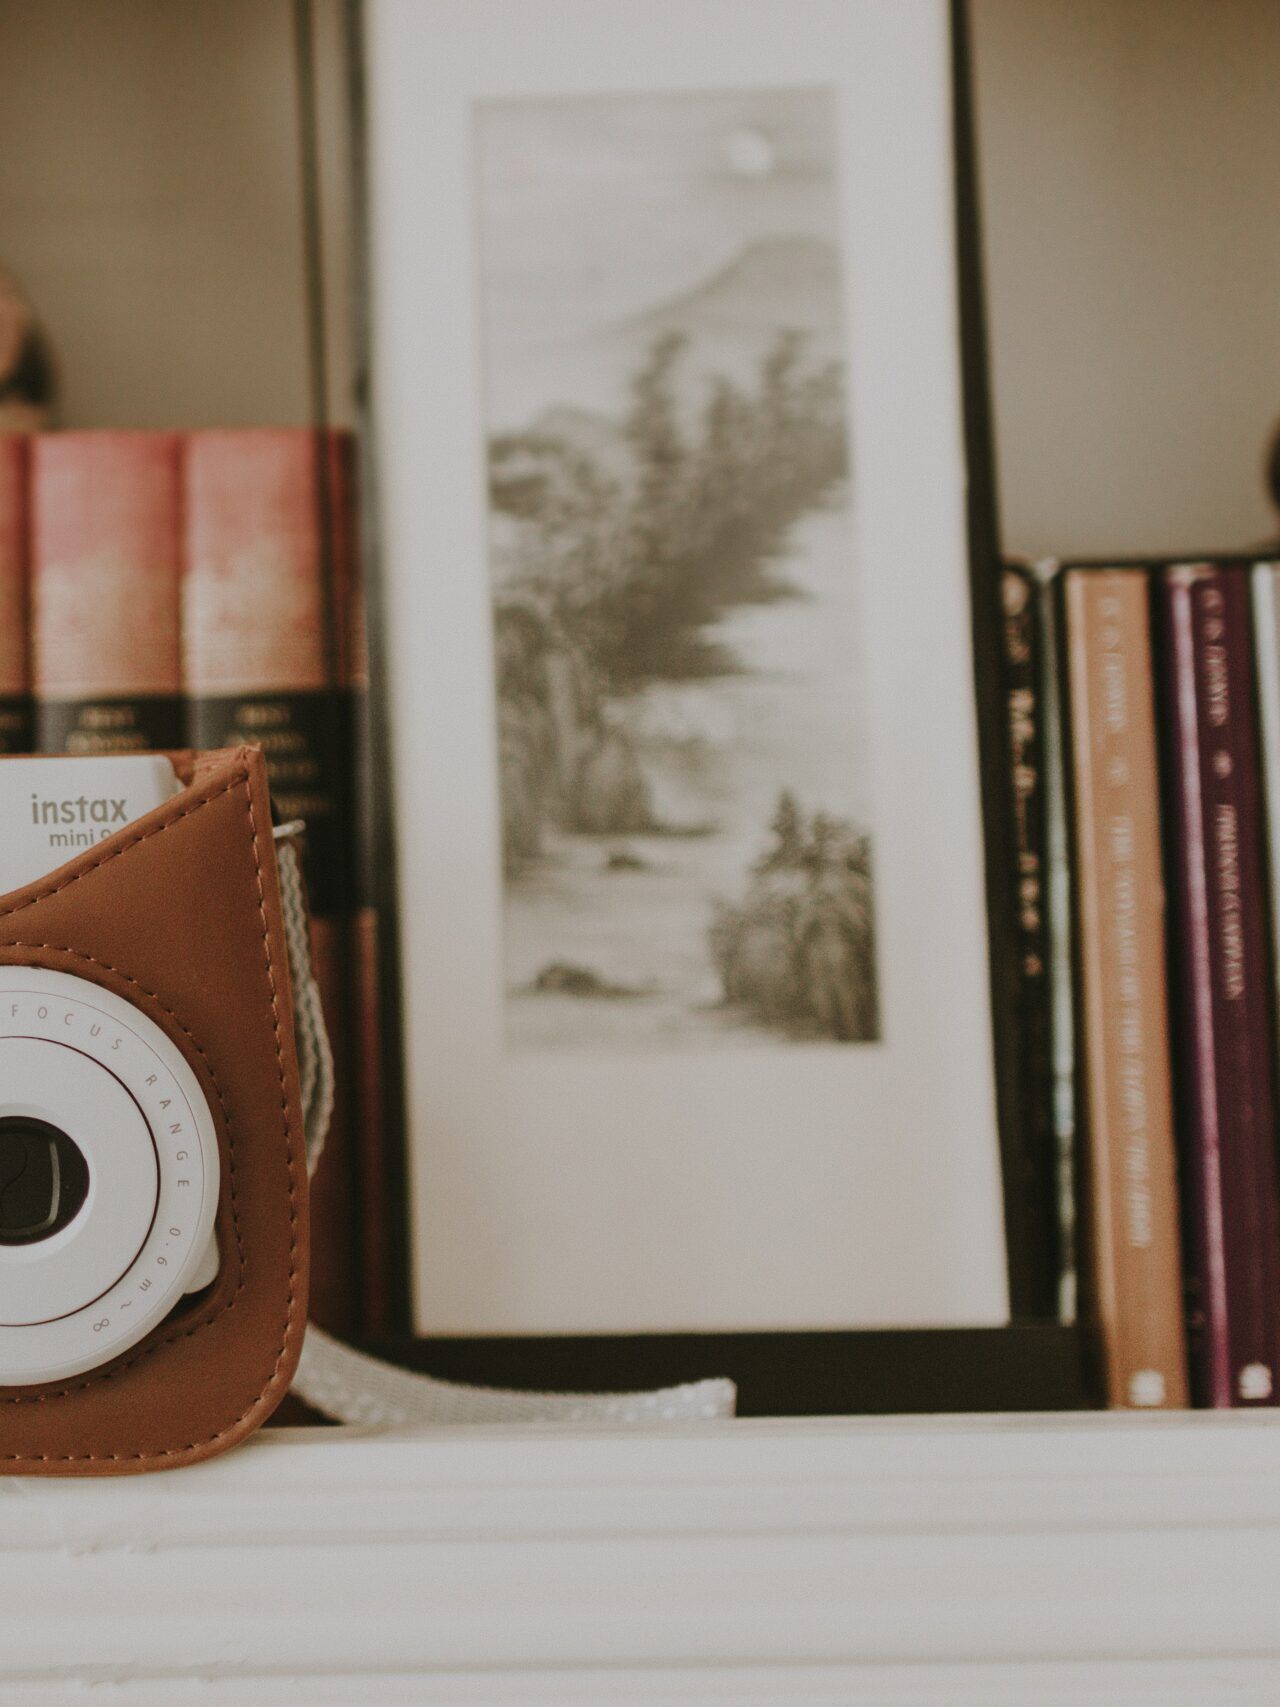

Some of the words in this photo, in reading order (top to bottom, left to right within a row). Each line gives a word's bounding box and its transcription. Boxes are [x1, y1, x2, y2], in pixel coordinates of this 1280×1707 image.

[31, 793, 128, 824] instax
[49, 829, 94, 847] mini
[11, 1004, 123, 1051] FOCUS
[145, 1073, 190, 1188] RANGE
